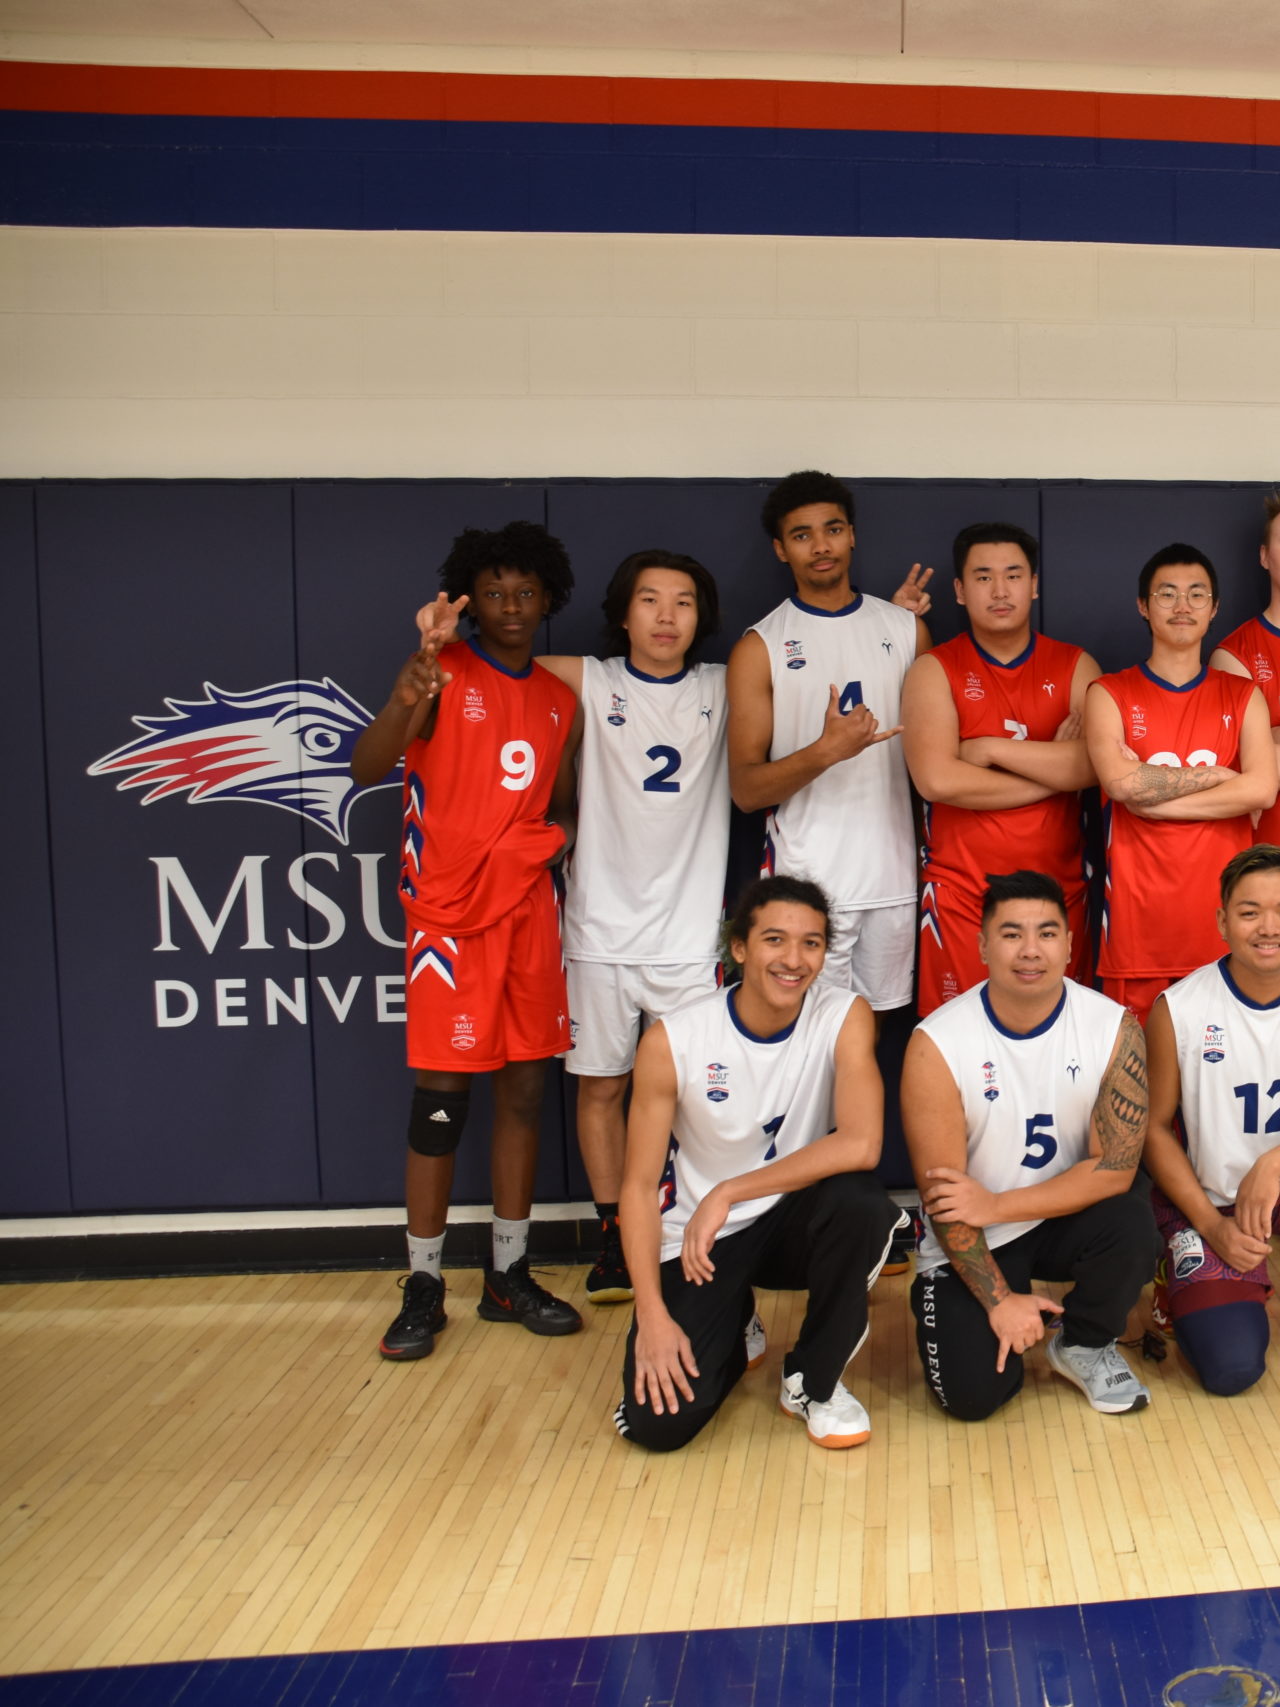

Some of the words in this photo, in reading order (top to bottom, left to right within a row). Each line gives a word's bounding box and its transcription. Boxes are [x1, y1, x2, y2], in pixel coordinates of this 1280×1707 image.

[500, 740, 536, 792] 9
[643, 745, 681, 792] 2
[154, 975, 408, 1028] DENVE
[1020, 1113, 1057, 1170] 5
[923, 1284, 936, 1328] MSU
